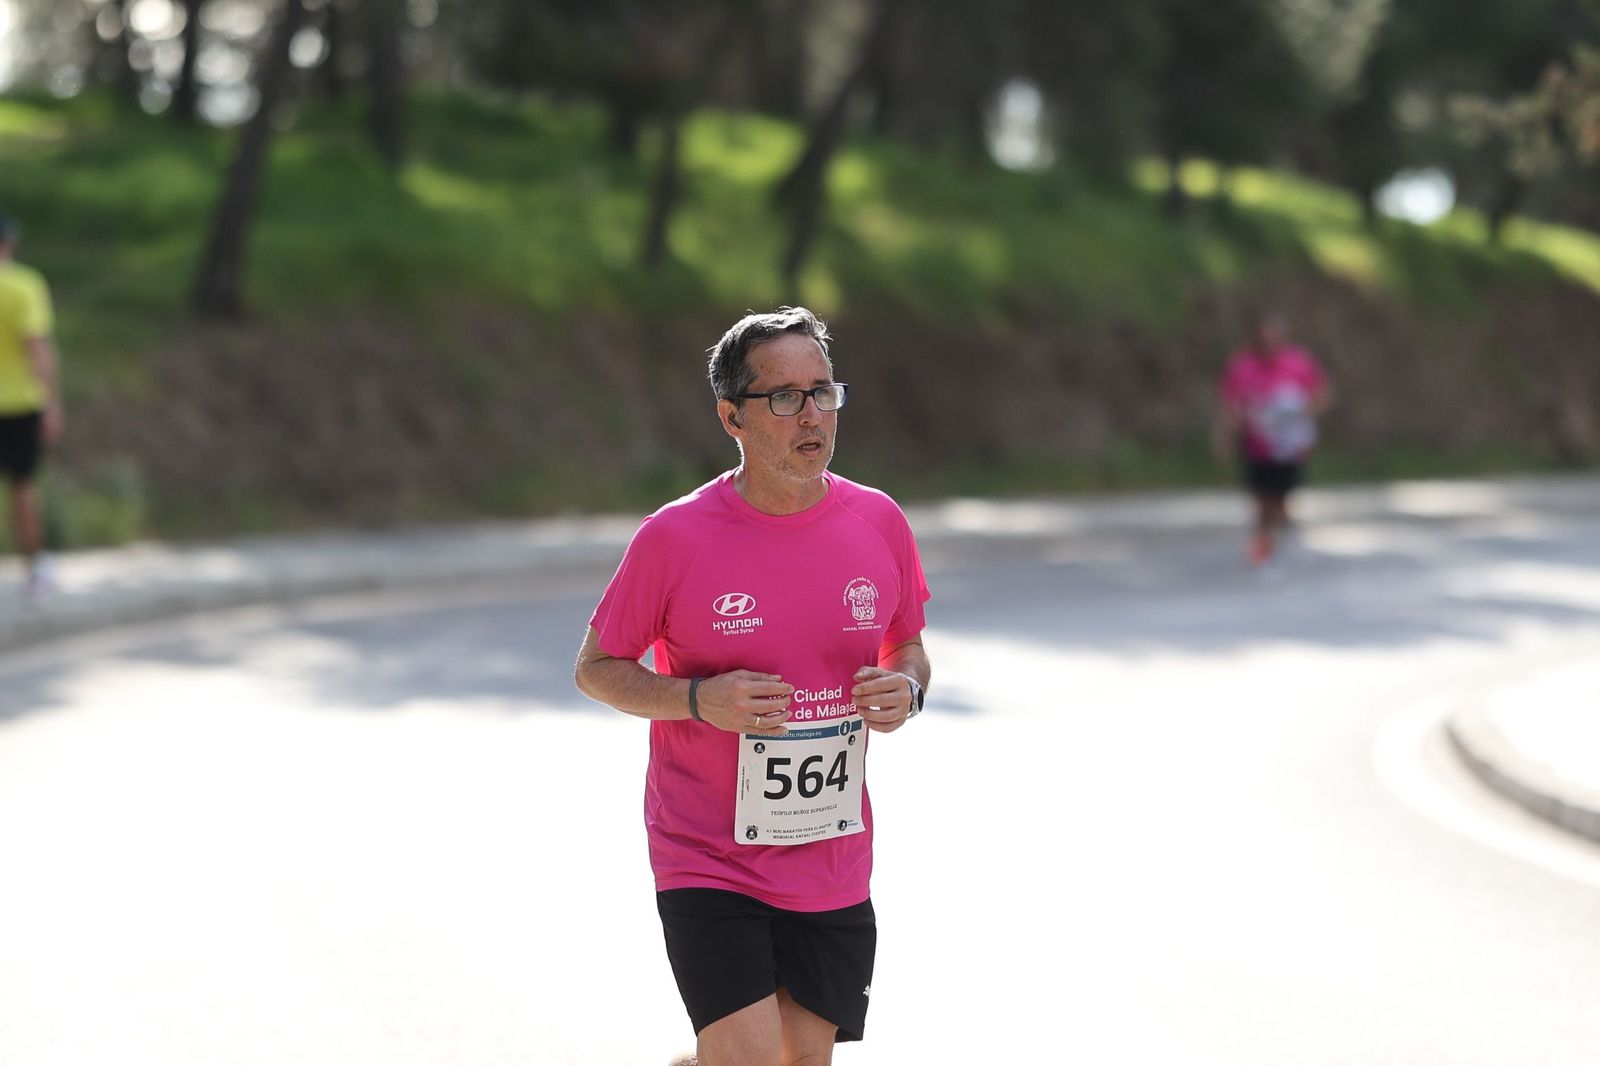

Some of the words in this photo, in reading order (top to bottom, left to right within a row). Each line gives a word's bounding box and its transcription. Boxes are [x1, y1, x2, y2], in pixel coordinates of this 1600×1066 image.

[712, 617, 763, 631] HYUNDAI
[794, 685, 843, 703] Ciudad
[794, 706, 813, 720] de
[763, 750, 849, 800] 564
